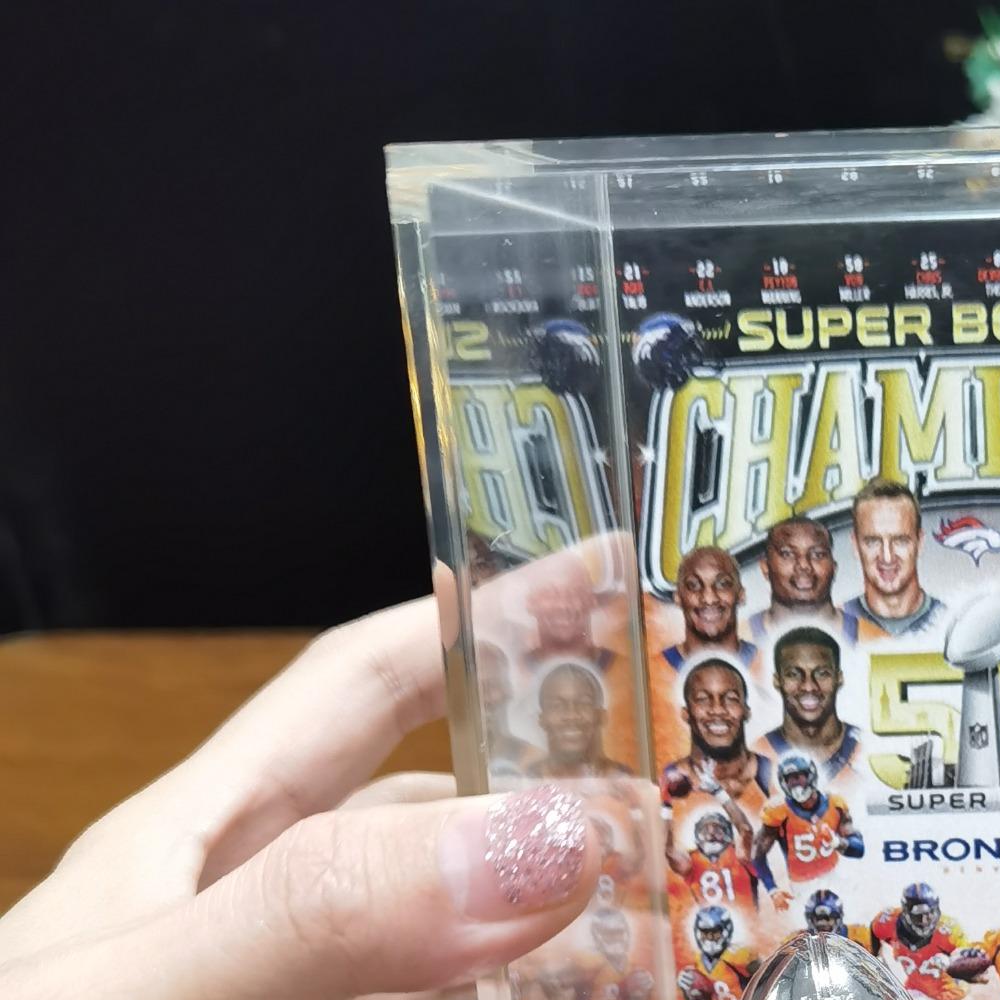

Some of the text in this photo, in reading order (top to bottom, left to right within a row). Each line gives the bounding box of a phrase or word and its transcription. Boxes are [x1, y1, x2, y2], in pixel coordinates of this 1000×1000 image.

[737, 303, 933, 351] SUPER
[888, 792, 986, 811] SUPER
[700, 869, 735, 901] 81
